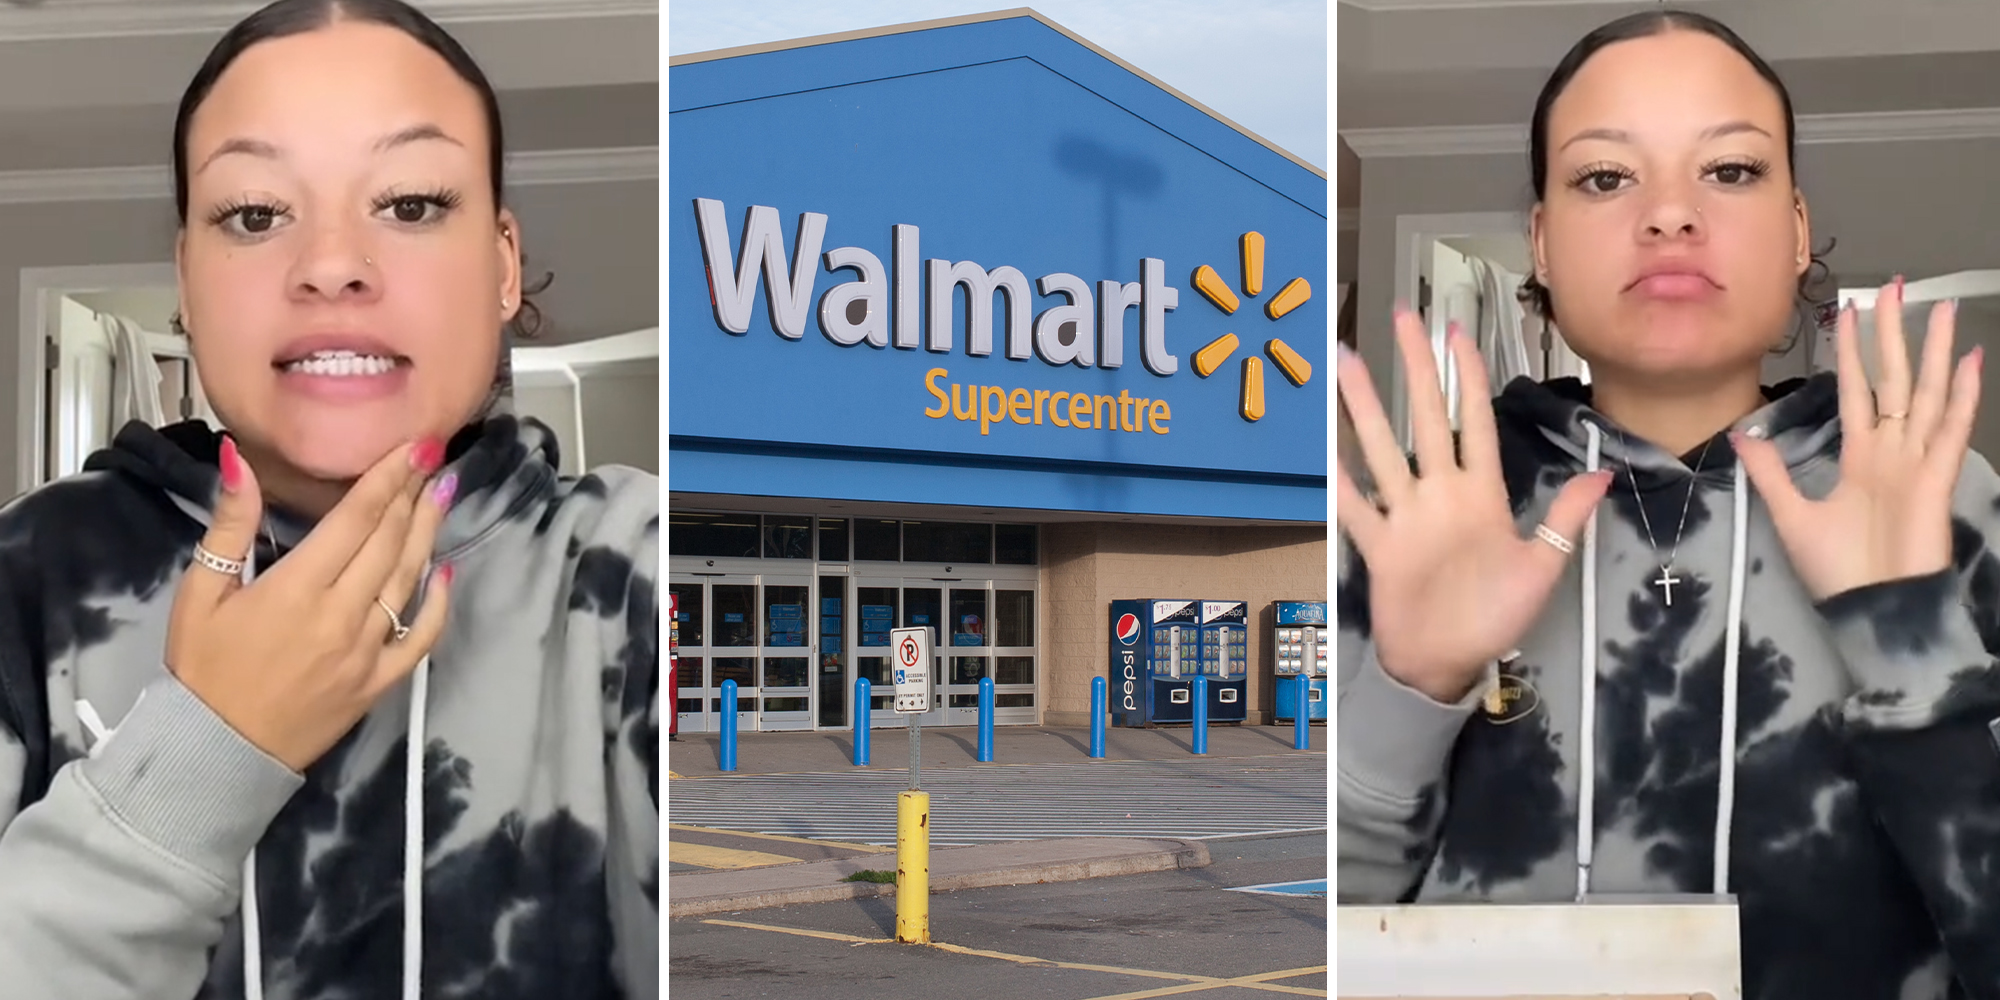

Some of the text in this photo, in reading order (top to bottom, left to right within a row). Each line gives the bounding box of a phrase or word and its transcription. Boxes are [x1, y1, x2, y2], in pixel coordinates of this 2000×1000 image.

[693, 197, 1178, 375] Walmart
[924, 367, 1171, 436] Supercentre
[1294, 608, 1325, 622] AQUAFINA
[1121, 650, 1137, 711] pepsi
